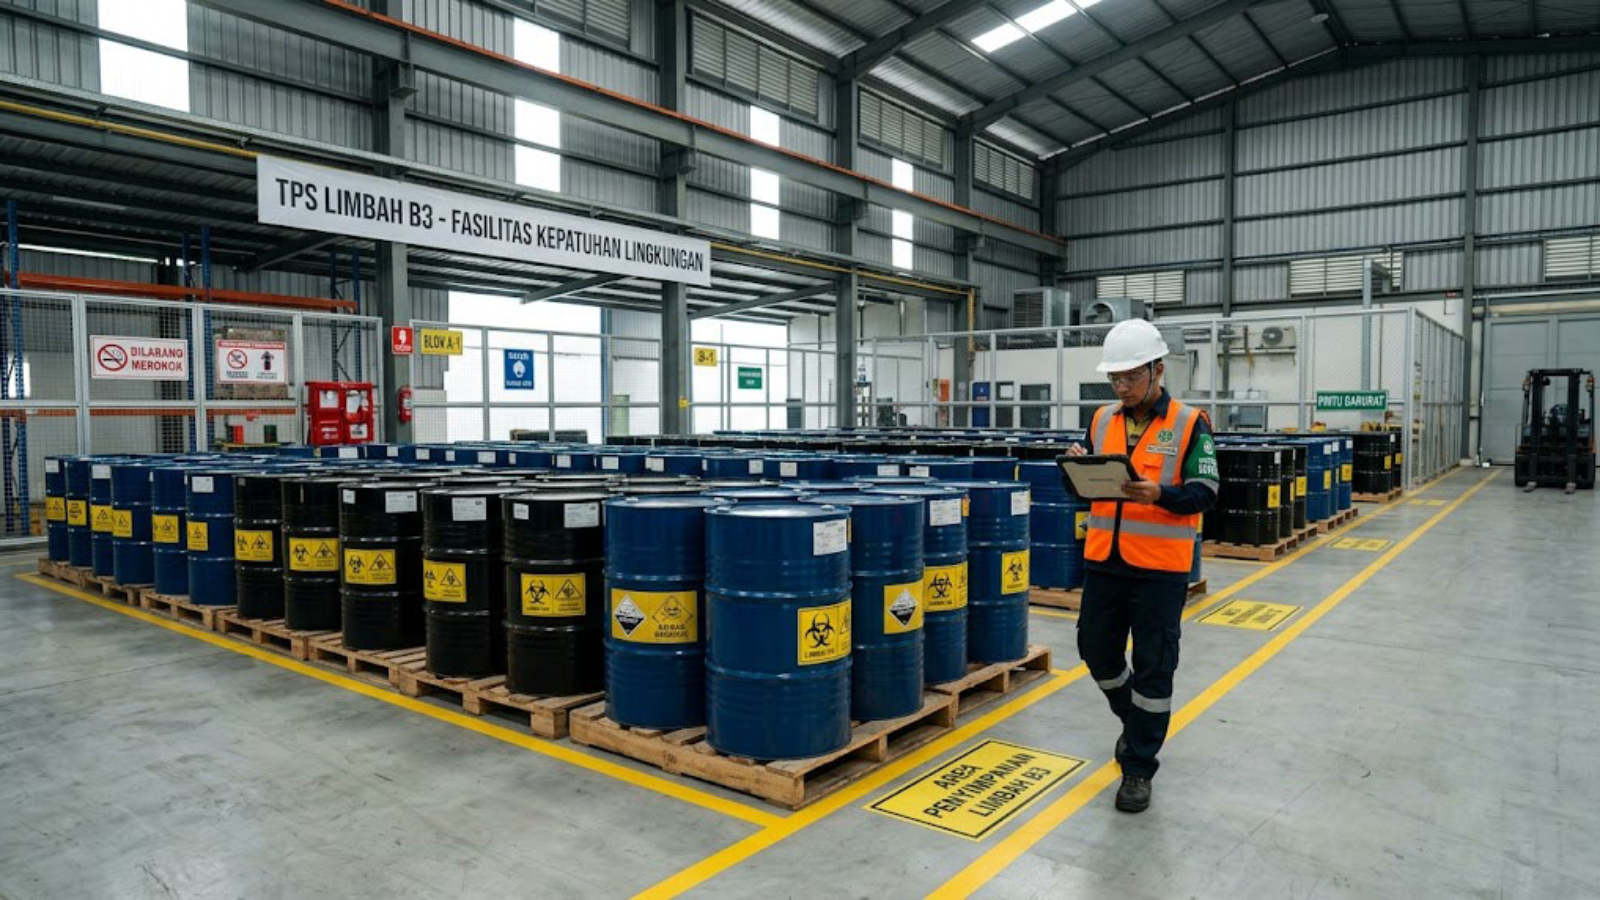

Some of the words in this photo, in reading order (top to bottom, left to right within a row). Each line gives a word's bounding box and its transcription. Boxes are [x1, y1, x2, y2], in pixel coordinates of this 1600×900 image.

[275, 177, 318, 212] TPS
[324, 186, 404, 225] LIMBAH
[409, 201, 434, 230] B3
[451, 208, 533, 246] FASILITAS
[537, 224, 621, 260] KEPATUHAN
[624, 239, 704, 273] LINGKUNGAN
[922, 753, 1037, 819] PENYIMPANAN
[968, 778, 1035, 817] LIMBAH
